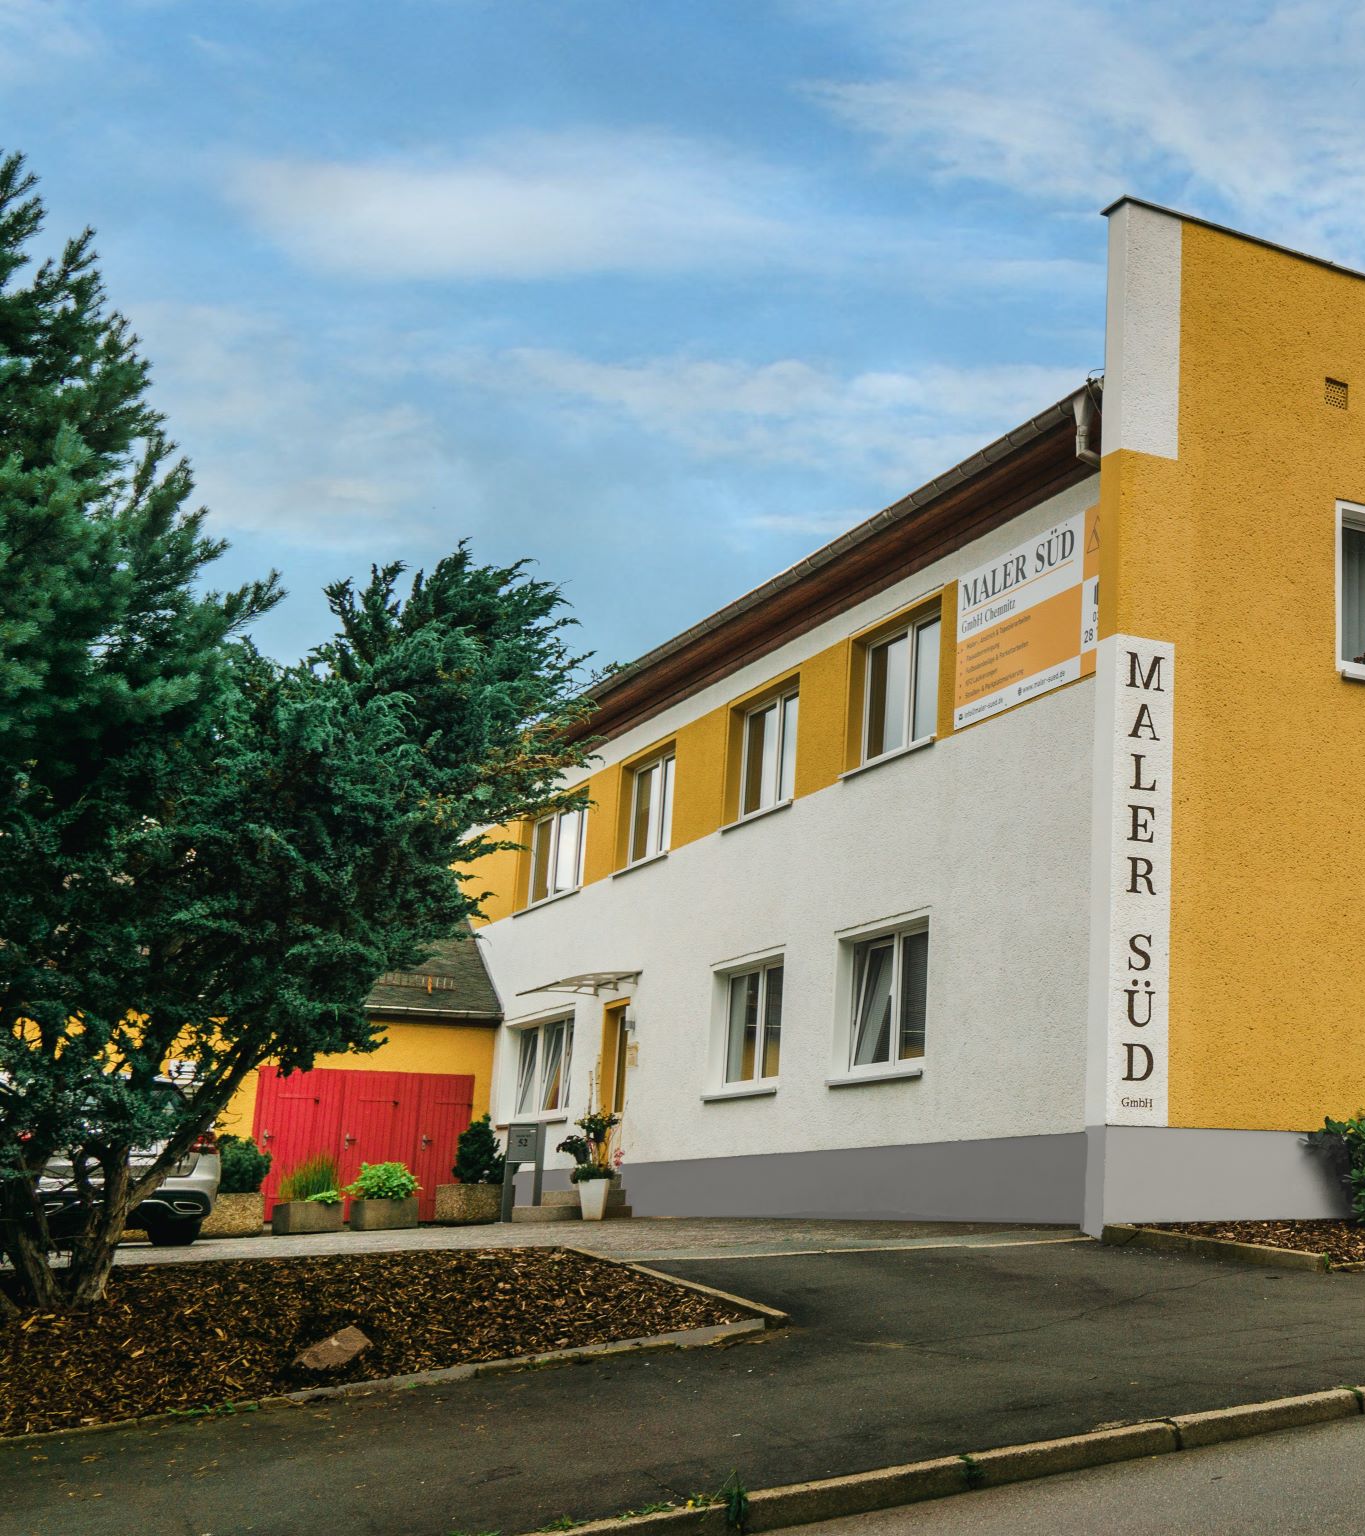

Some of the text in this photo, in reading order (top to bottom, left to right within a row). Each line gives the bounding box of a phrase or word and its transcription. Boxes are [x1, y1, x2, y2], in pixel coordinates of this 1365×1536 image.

[961, 528, 1075, 611] MALER SÜD
[961, 599, 1016, 634] GmbH Chemnitz
[1084, 628, 1094, 644] 28
[1121, 651, 1166, 1082] MALER SÜD
[1121, 1097, 1153, 1108] GmbH
